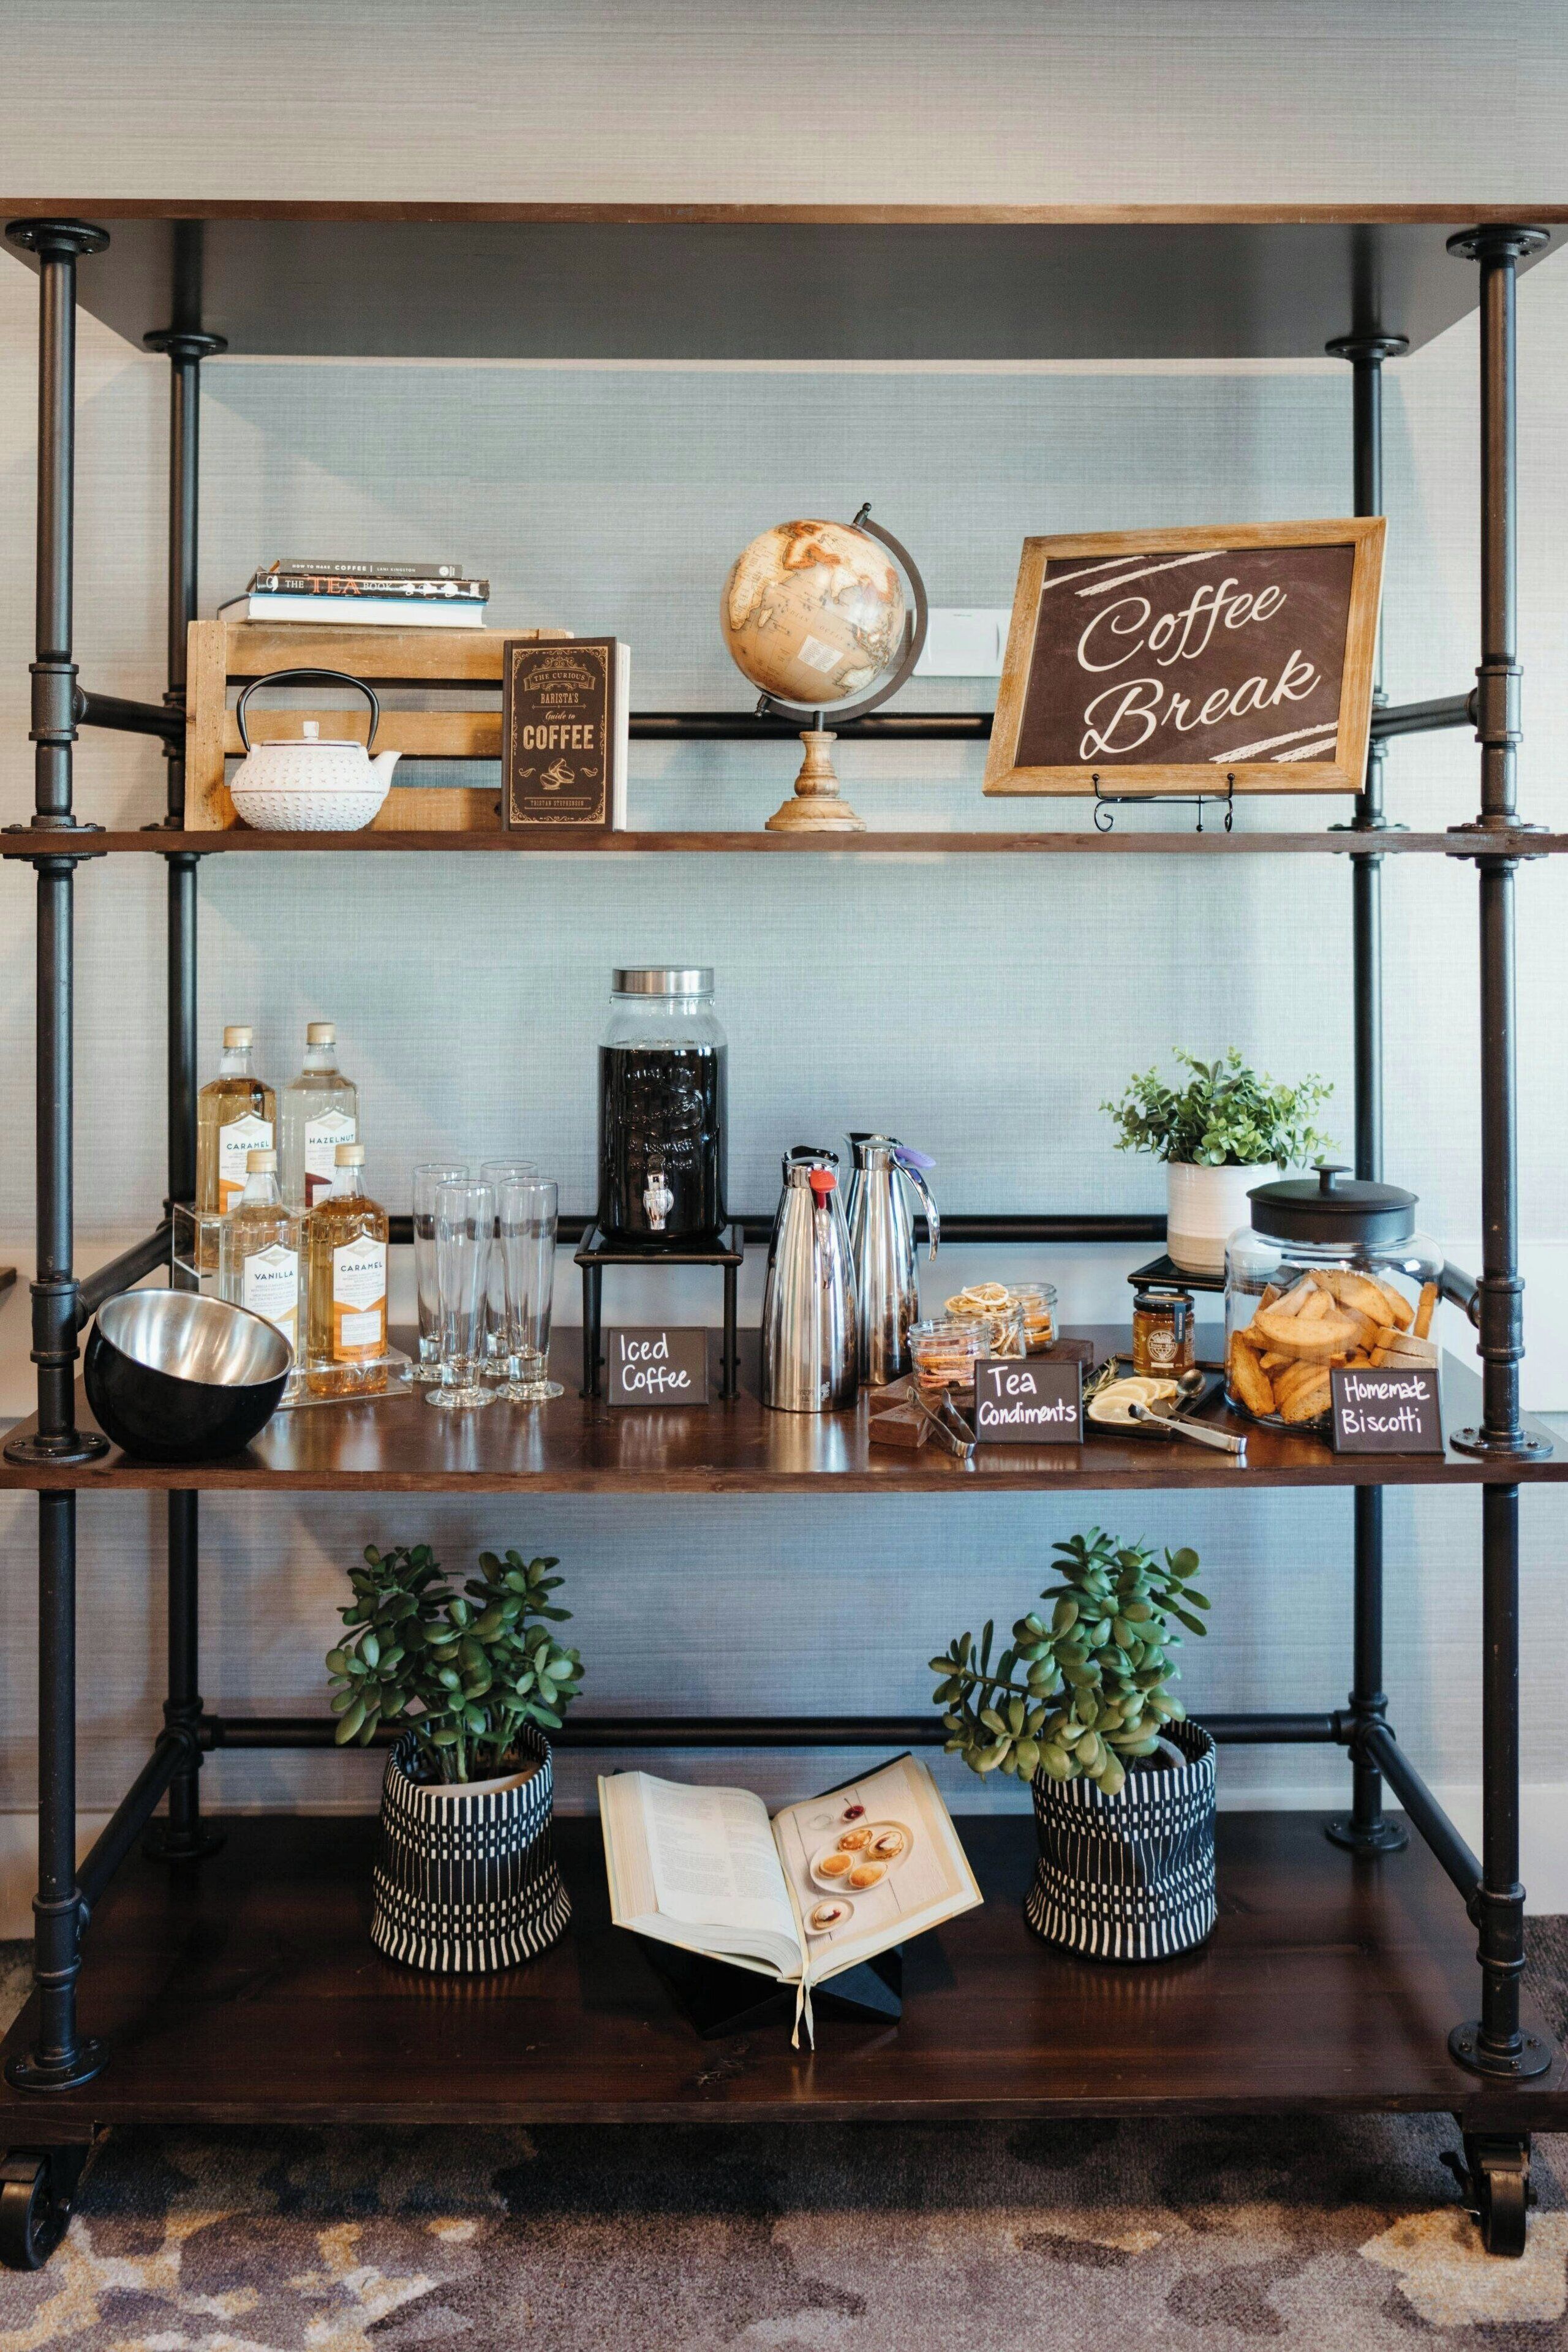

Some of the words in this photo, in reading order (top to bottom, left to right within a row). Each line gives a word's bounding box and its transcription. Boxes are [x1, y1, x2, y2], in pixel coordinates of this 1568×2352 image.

[285, 580, 304, 589] THE
[307, 576, 361, 595] TEA
[363, 582, 392, 592] BOOK
[1077, 578, 1287, 672] Coffee
[534, 673, 549, 682] THE
[541, 693, 579, 704] BARISTA'S
[1079, 649, 1321, 760] Break
[545, 710, 567, 720] Guide
[523, 725, 594, 750] COFFEE
[227, 1140, 269, 1150] CARAMEL
[309, 1134, 354, 1144] HAZELNUT
[255, 1270, 294, 1280] VANILLA
[341, 1262, 383, 1272] CARAMEL
[621, 1333, 669, 1361] Iced
[622, 1364, 691, 1394] Coffee
[987, 1366, 1037, 1397] Tea
[1344, 1376, 1430, 1403] Homemade
[979, 1398, 1077, 1425] Condiments
[1341, 1406, 1422, 1434] Biscotti
